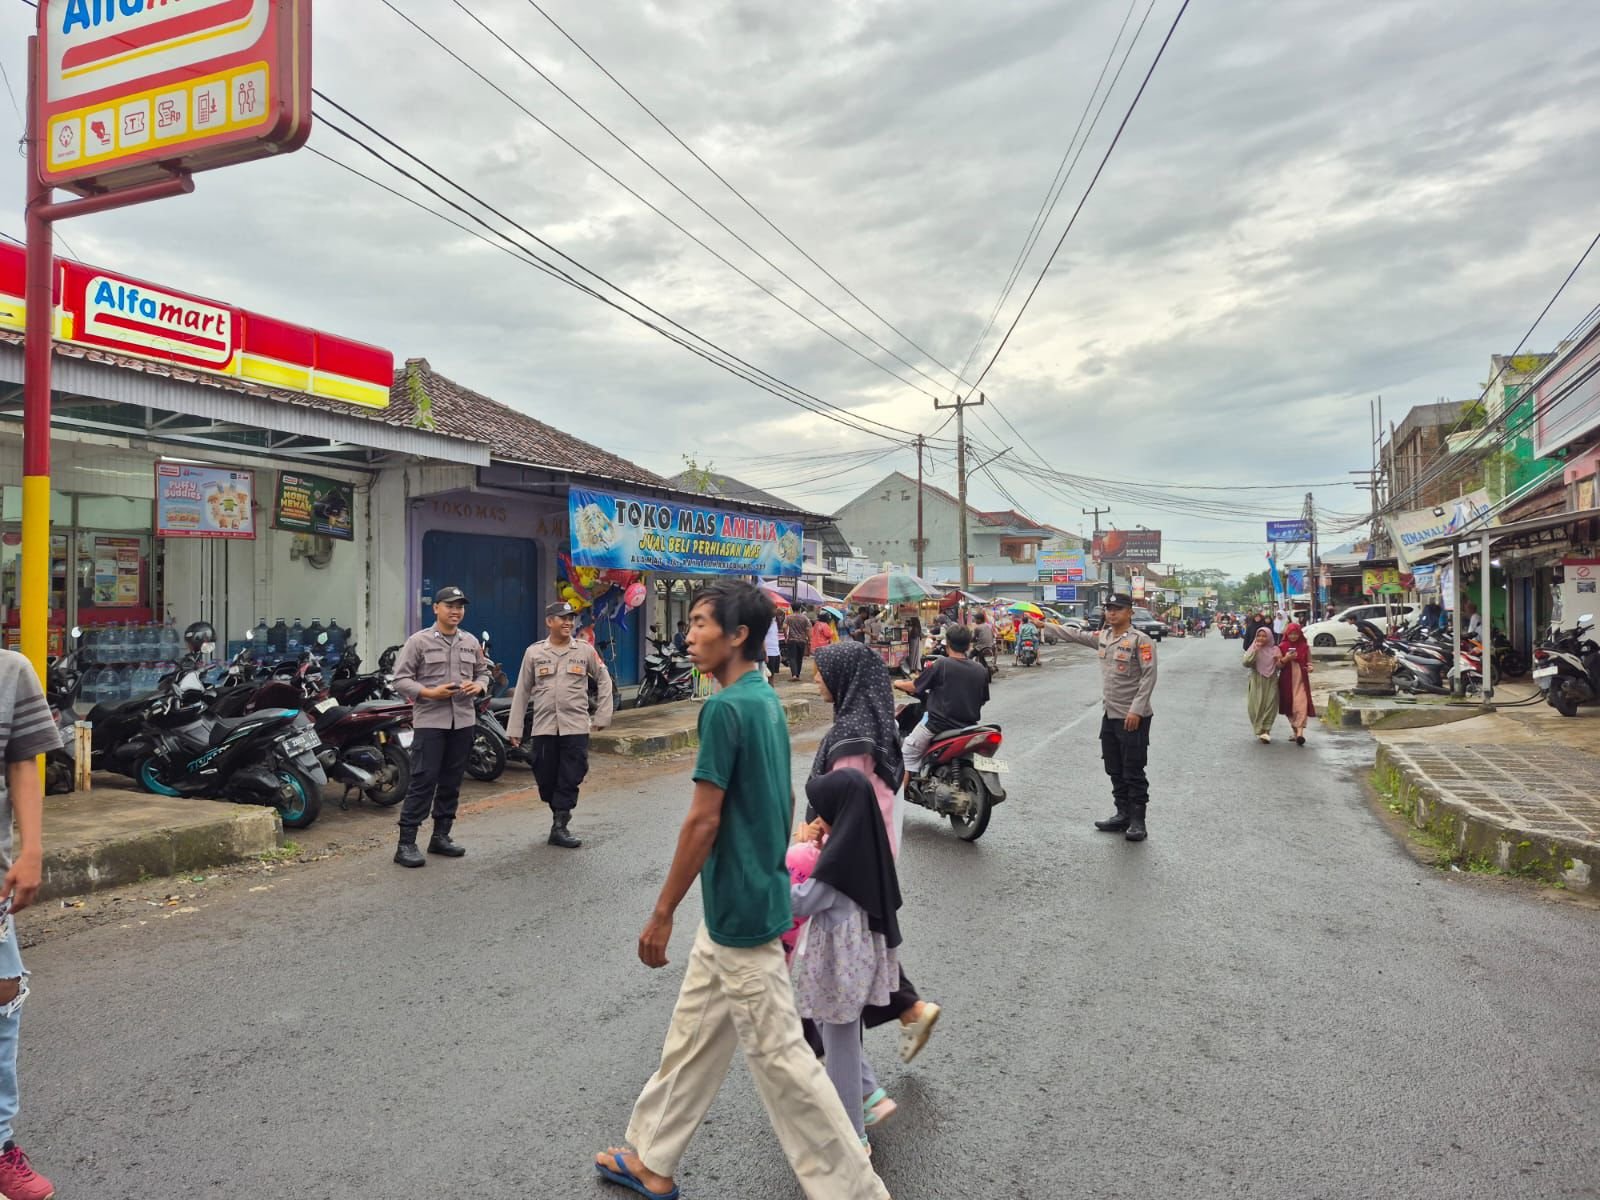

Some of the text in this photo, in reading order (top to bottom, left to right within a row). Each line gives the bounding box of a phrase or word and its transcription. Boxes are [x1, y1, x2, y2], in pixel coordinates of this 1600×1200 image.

[95, 281, 225, 335] Alfamart
[164, 488, 202, 501] Buddies
[169, 480, 197, 490] Puffy
[432, 500, 472, 518] TOKO
[475, 504, 507, 522] MAS
[615, 498, 777, 543] TOKO MAS AMELIA
[638, 533, 665, 552] JUAL
[668, 536, 690, 554] BELI
[693, 538, 741, 558] PERHIASAN
